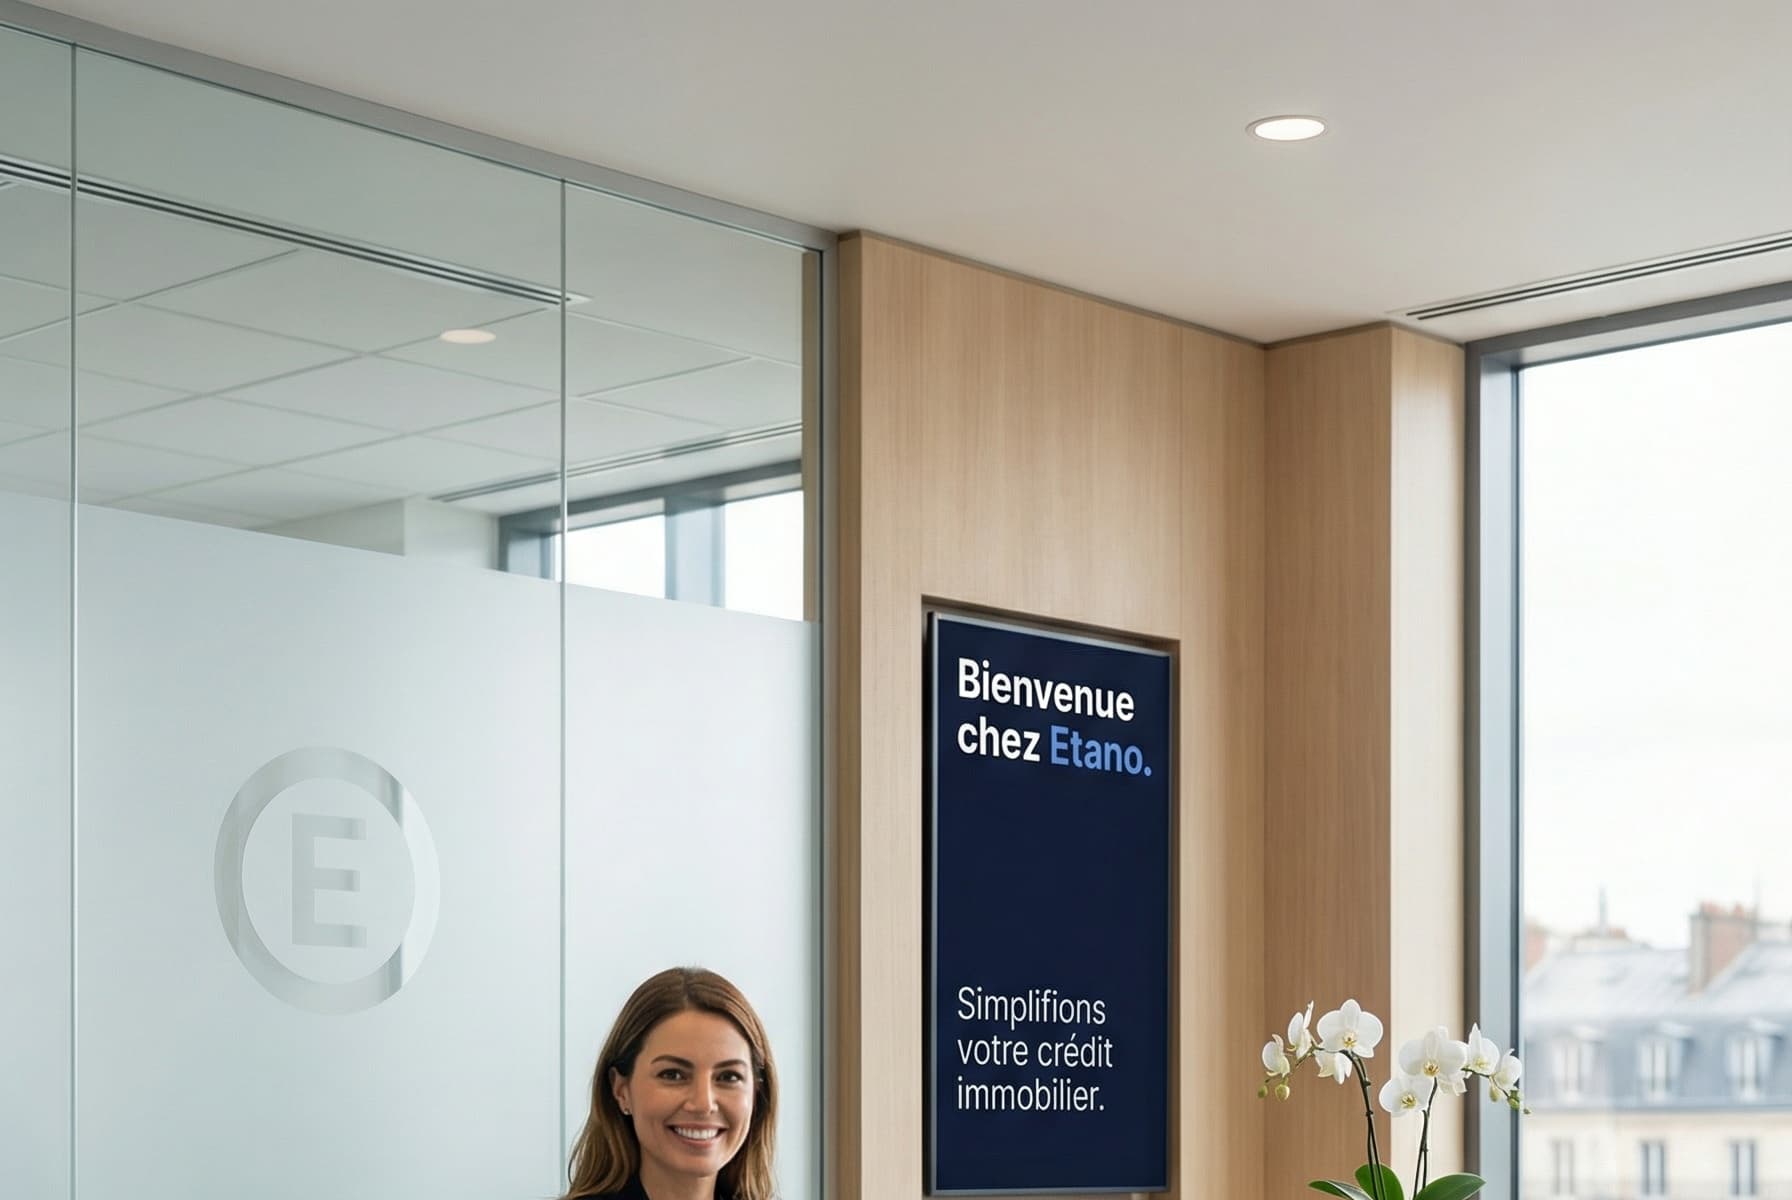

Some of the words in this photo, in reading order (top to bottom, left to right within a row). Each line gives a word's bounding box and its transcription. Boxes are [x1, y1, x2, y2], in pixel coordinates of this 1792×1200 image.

[957, 657, 1135, 722] Bienvenue
[957, 715, 1041, 762] chez
[1050, 725, 1152, 777] Etano.
[291, 813, 367, 949] E
[957, 986, 1106, 1031] Simplifions
[957, 1034, 1029, 1066] votre
[1037, 1032, 1113, 1068] crédit
[957, 1075, 1105, 1111] immobilier.
